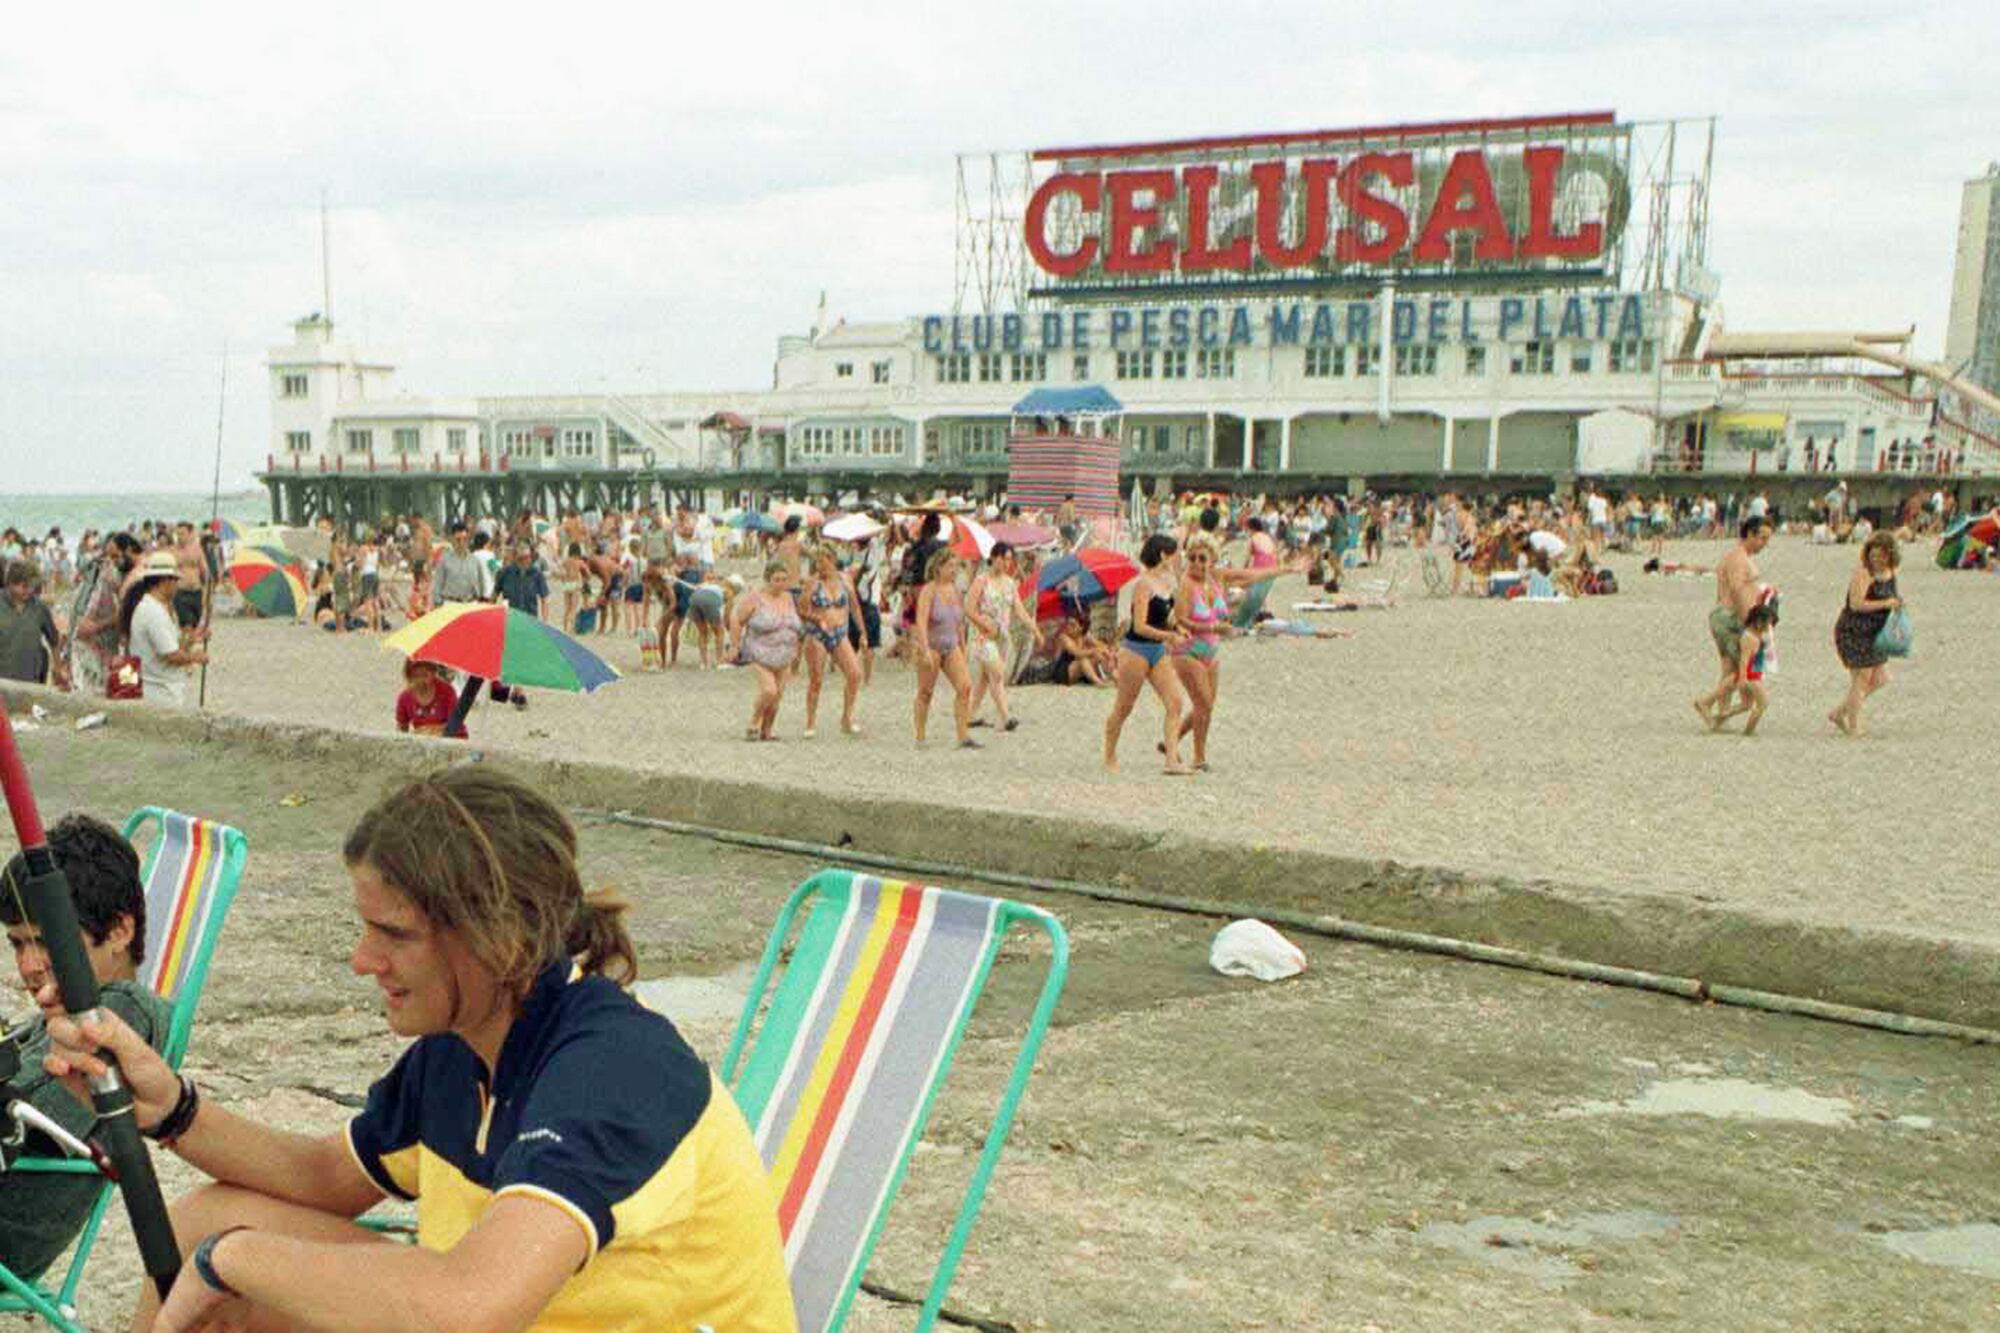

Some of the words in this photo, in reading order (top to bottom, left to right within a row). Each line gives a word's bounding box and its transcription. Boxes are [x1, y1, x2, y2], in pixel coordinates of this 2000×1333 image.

[1025, 146, 1602, 277] CELUSAL
[923, 314, 1021, 353] CLUB
[1043, 311, 1090, 350] DE
[1110, 306, 1253, 348] PESCA
[1271, 303, 1371, 345] MAR
[1393, 301, 1478, 343] DEL
[1498, 295, 1642, 342] PLATA
